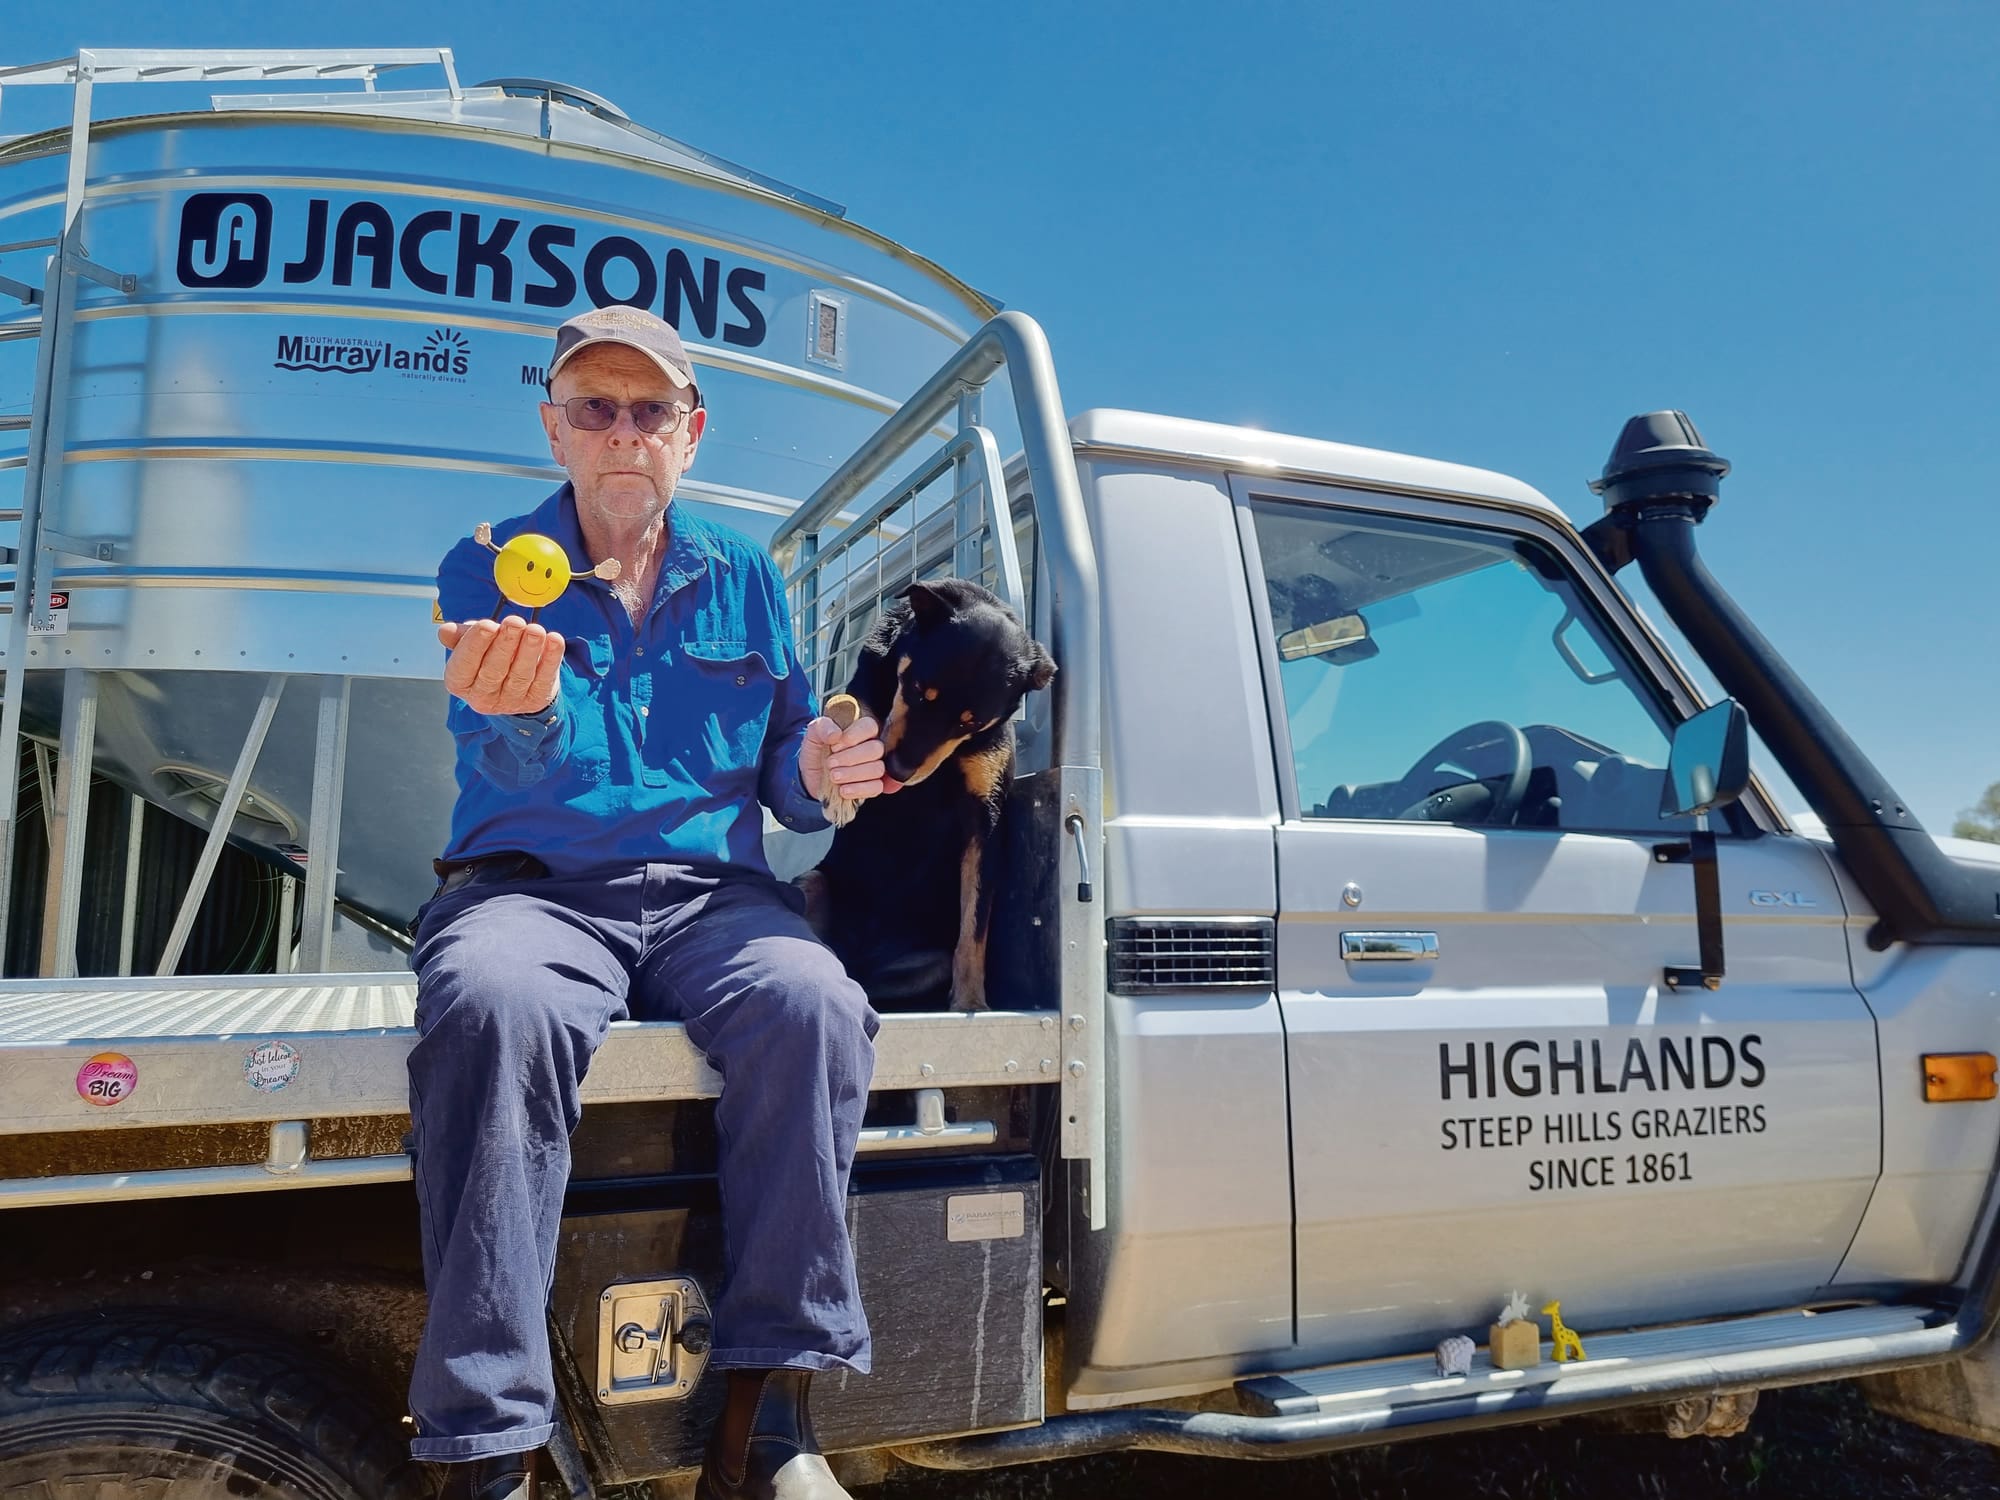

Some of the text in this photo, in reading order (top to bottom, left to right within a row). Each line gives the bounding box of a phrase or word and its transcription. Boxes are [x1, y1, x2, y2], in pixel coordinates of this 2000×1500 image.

[283, 199, 767, 348] JACKSONS
[275, 335, 469, 375] Murraylands
[304, 336, 383, 347] SOUTH AUSTRALIA
[401, 372, 467, 384] naturally diverse
[1748, 889, 1816, 908] GXL
[81, 1062, 137, 1080] Dream
[1439, 1033, 1766, 1100] HIGHLANDS
[88, 1080, 122, 1098] BIG
[1441, 1104, 1767, 1150] STEEP HILLS GRAZIERS
[1528, 1152, 1693, 1191] SINCE 1861
